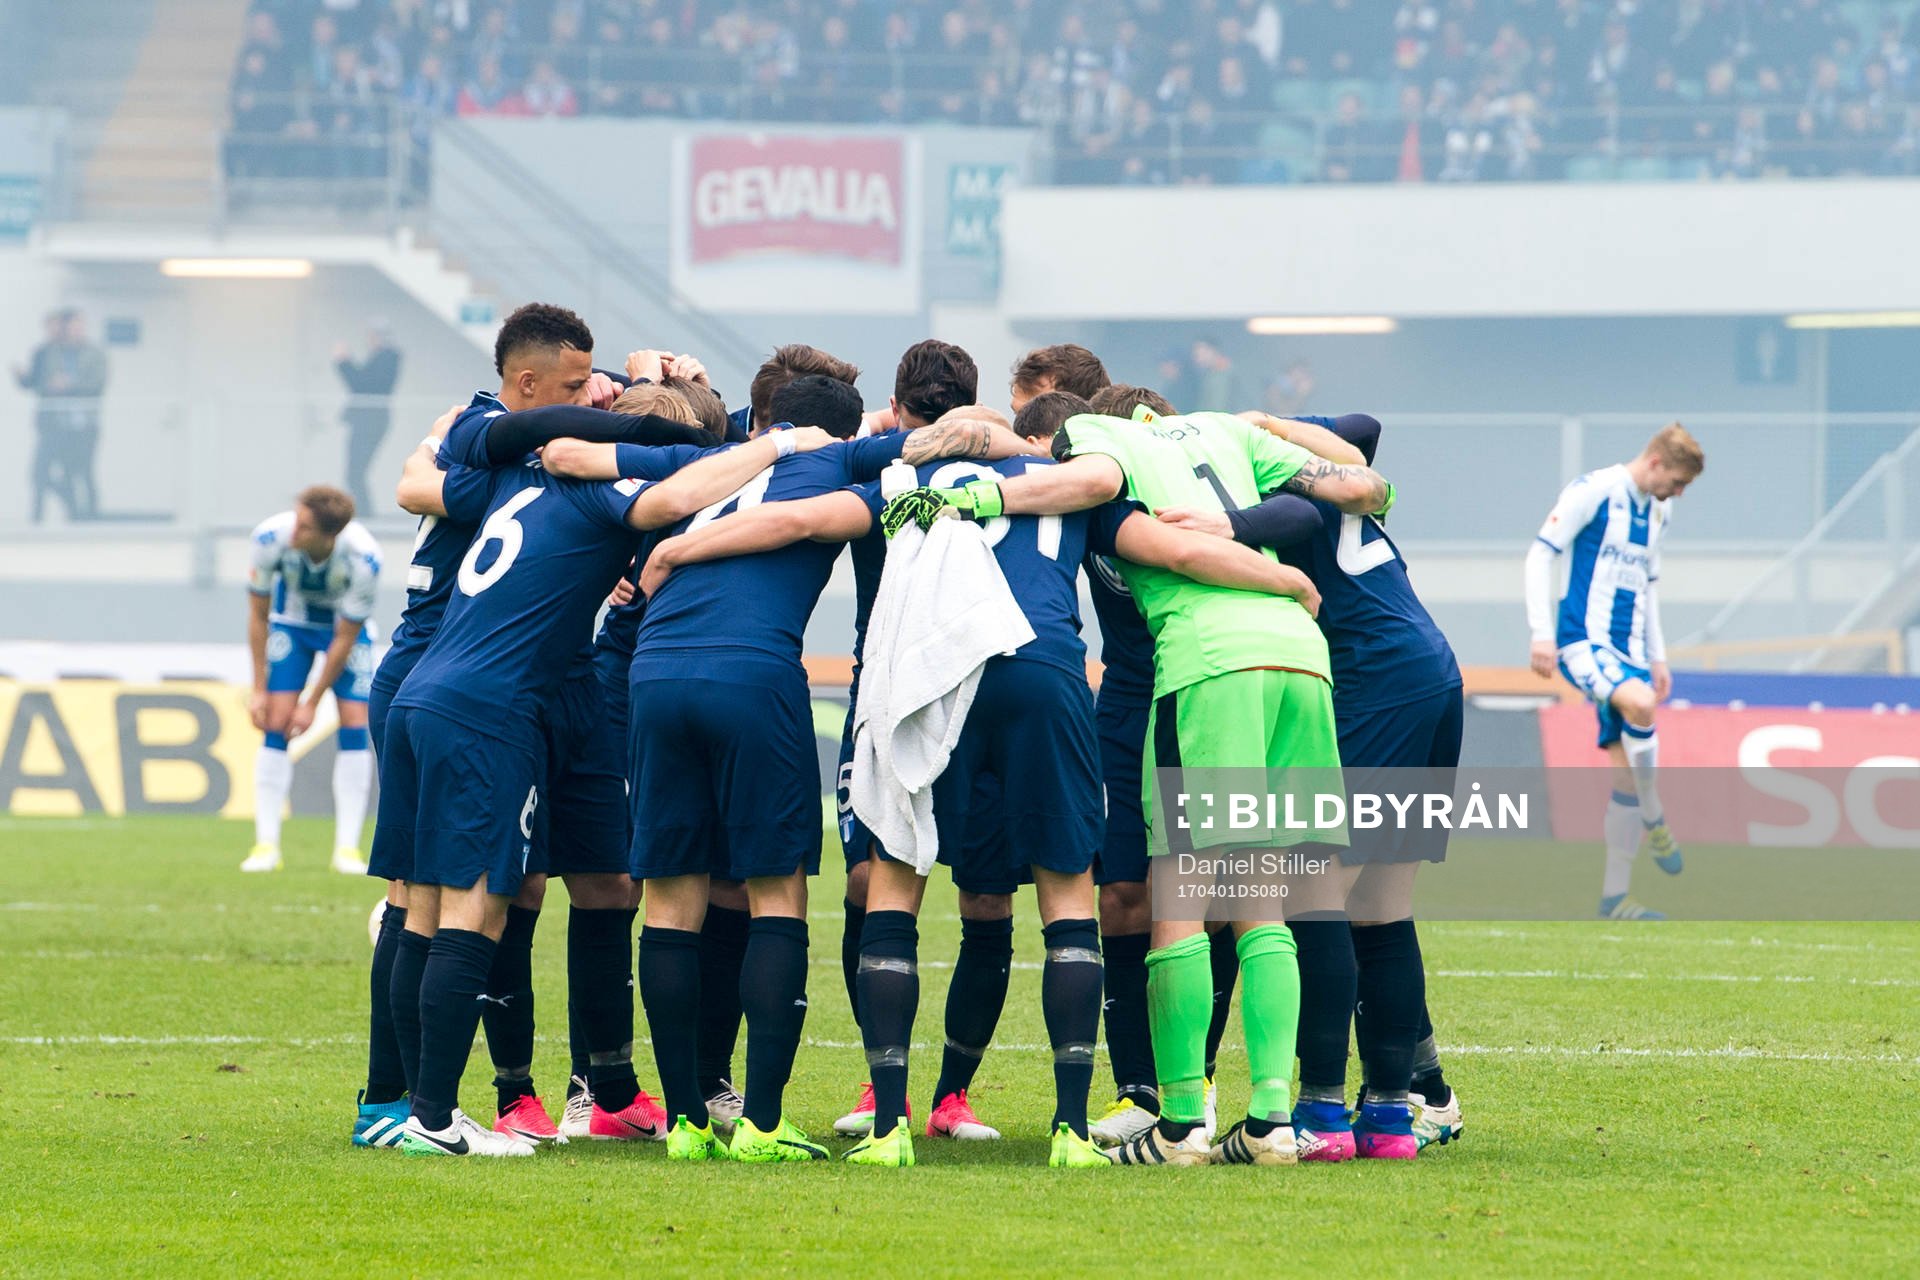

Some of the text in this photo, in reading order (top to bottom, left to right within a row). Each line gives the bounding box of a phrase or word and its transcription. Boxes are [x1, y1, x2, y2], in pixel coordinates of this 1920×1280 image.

[697, 164, 897, 231] GEVALIA
[1192, 463, 1240, 512] 1
[458, 486, 547, 598] 6
[0, 691, 233, 814] AB
